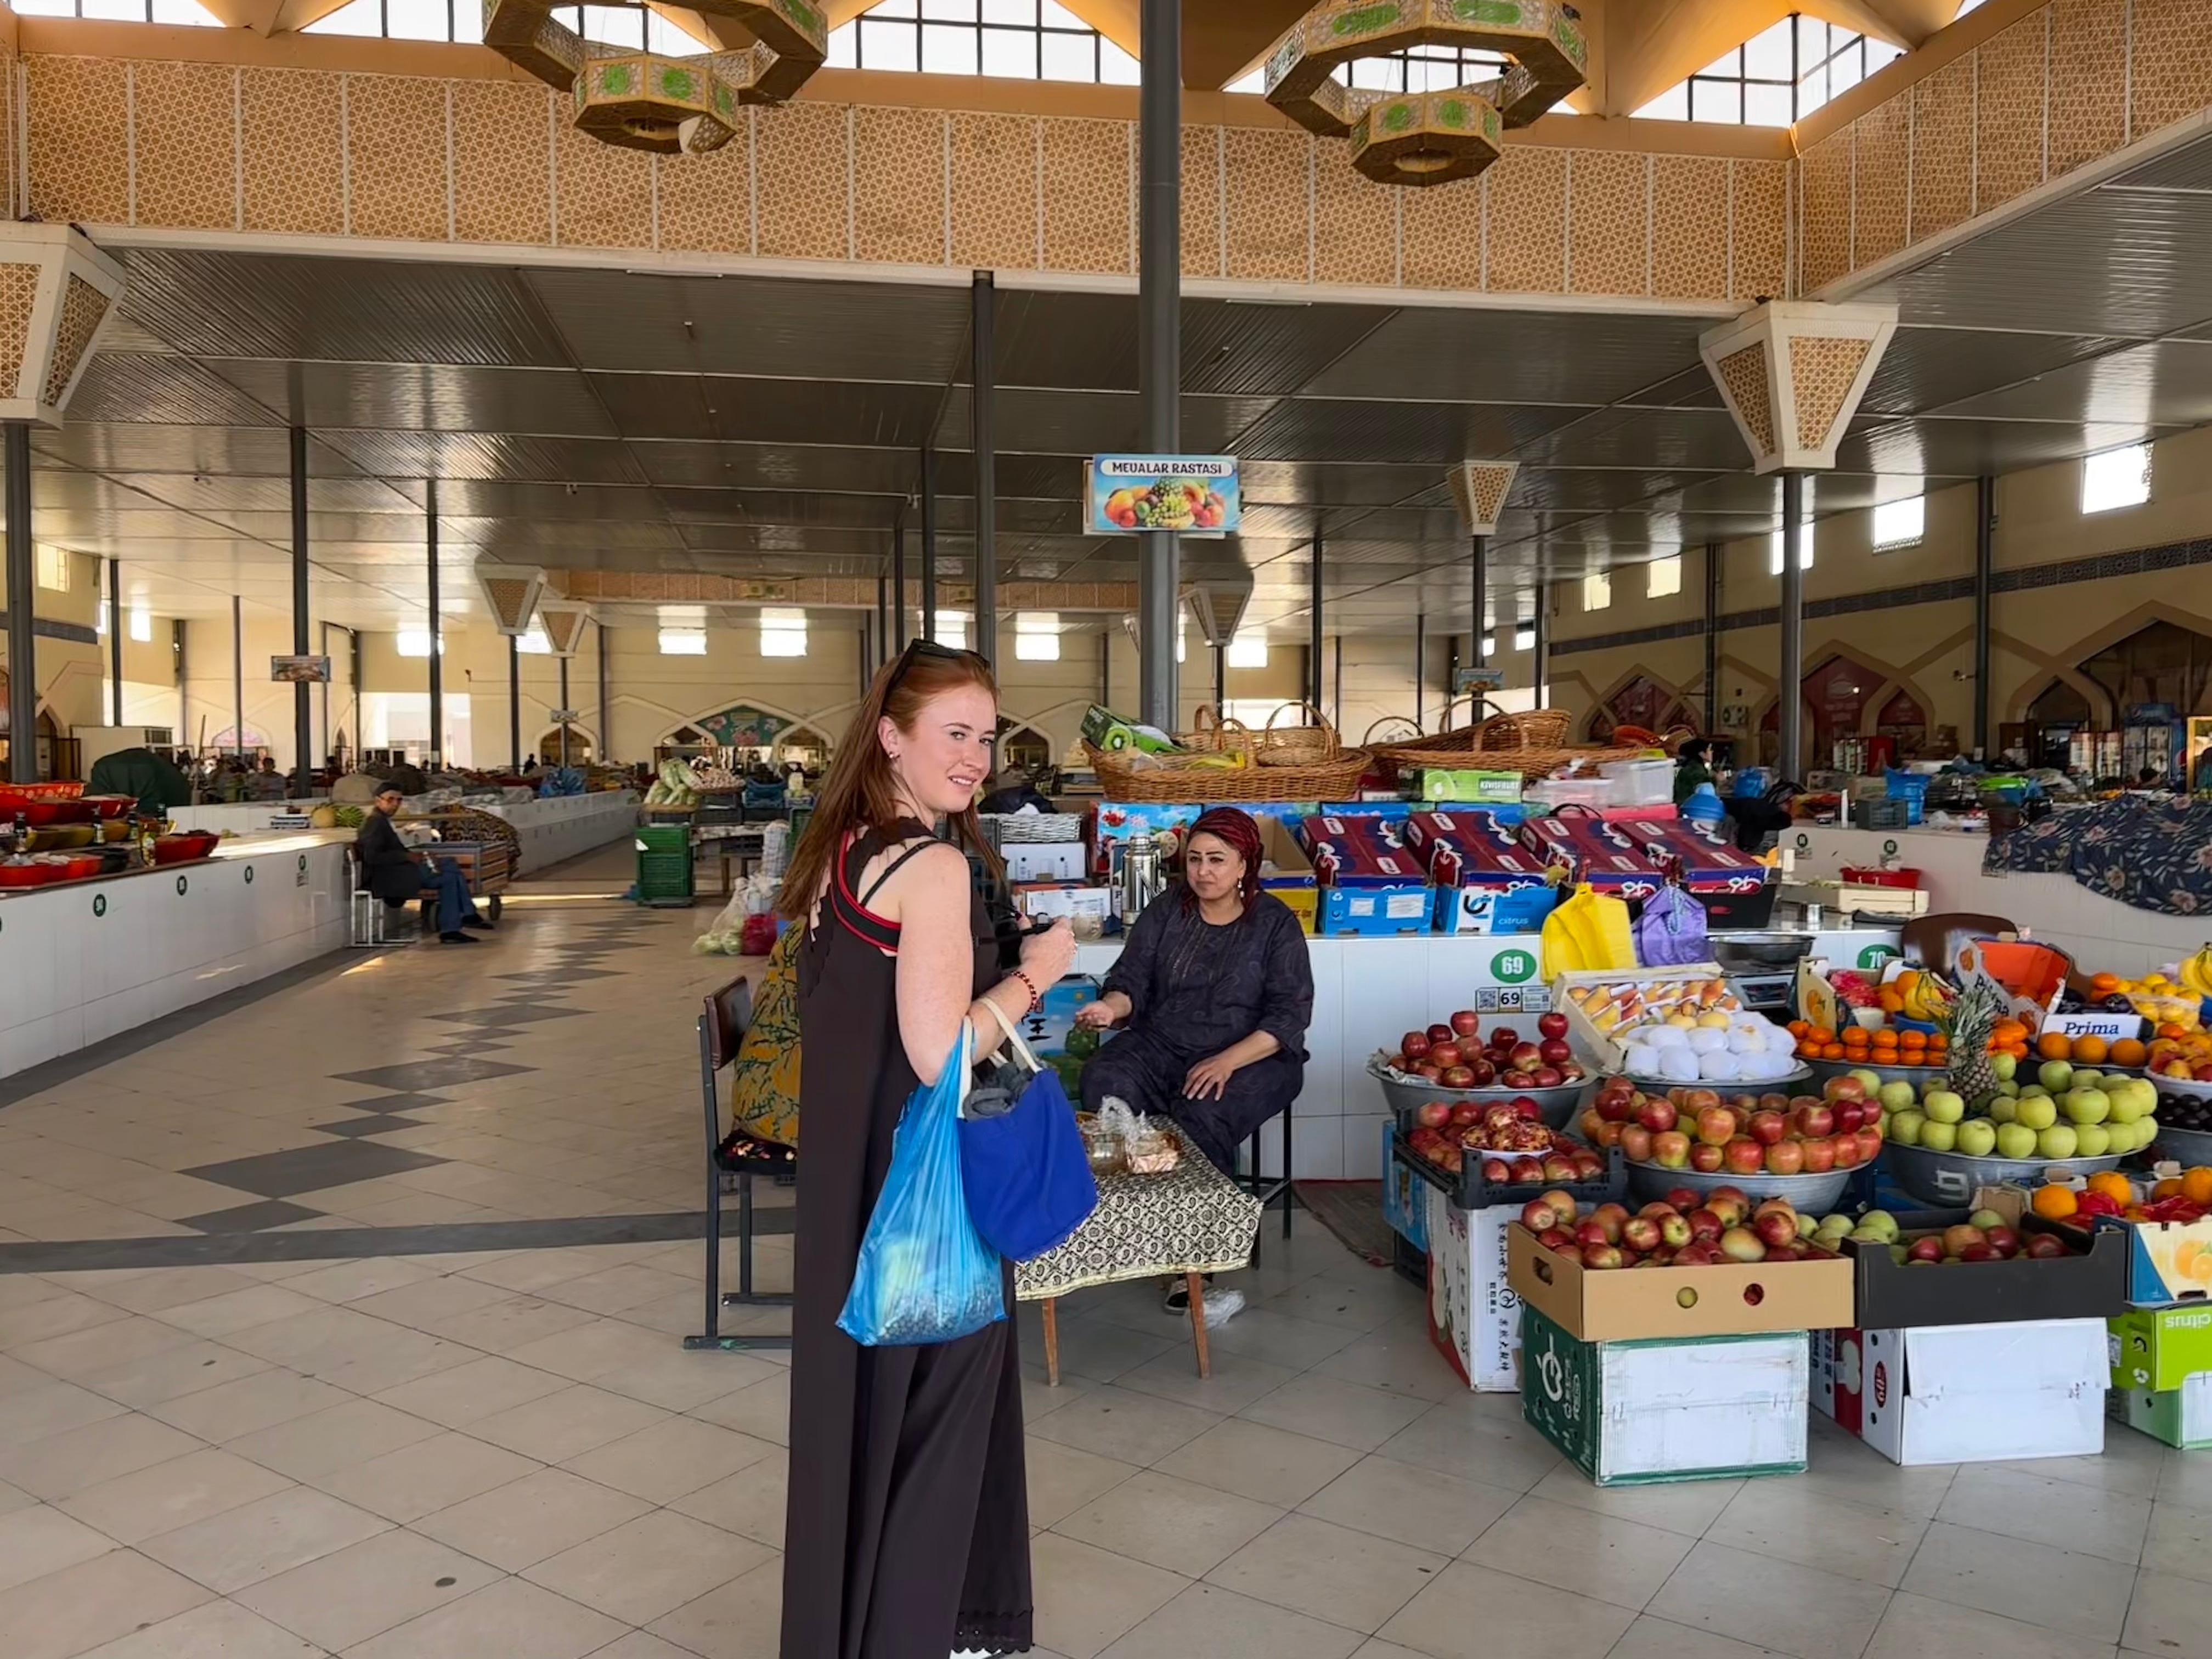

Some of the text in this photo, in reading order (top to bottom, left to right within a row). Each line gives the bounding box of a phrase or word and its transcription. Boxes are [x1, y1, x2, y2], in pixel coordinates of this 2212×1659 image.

[1172, 463, 1221, 474] RASTASI
[1498, 917, 1529, 925] citrus
[1501, 956, 1523, 975] 69
[1868, 951, 1886, 968] 70
[1500, 992, 1520, 1005] 69
[2064, 1021, 2119, 1034] Prima
